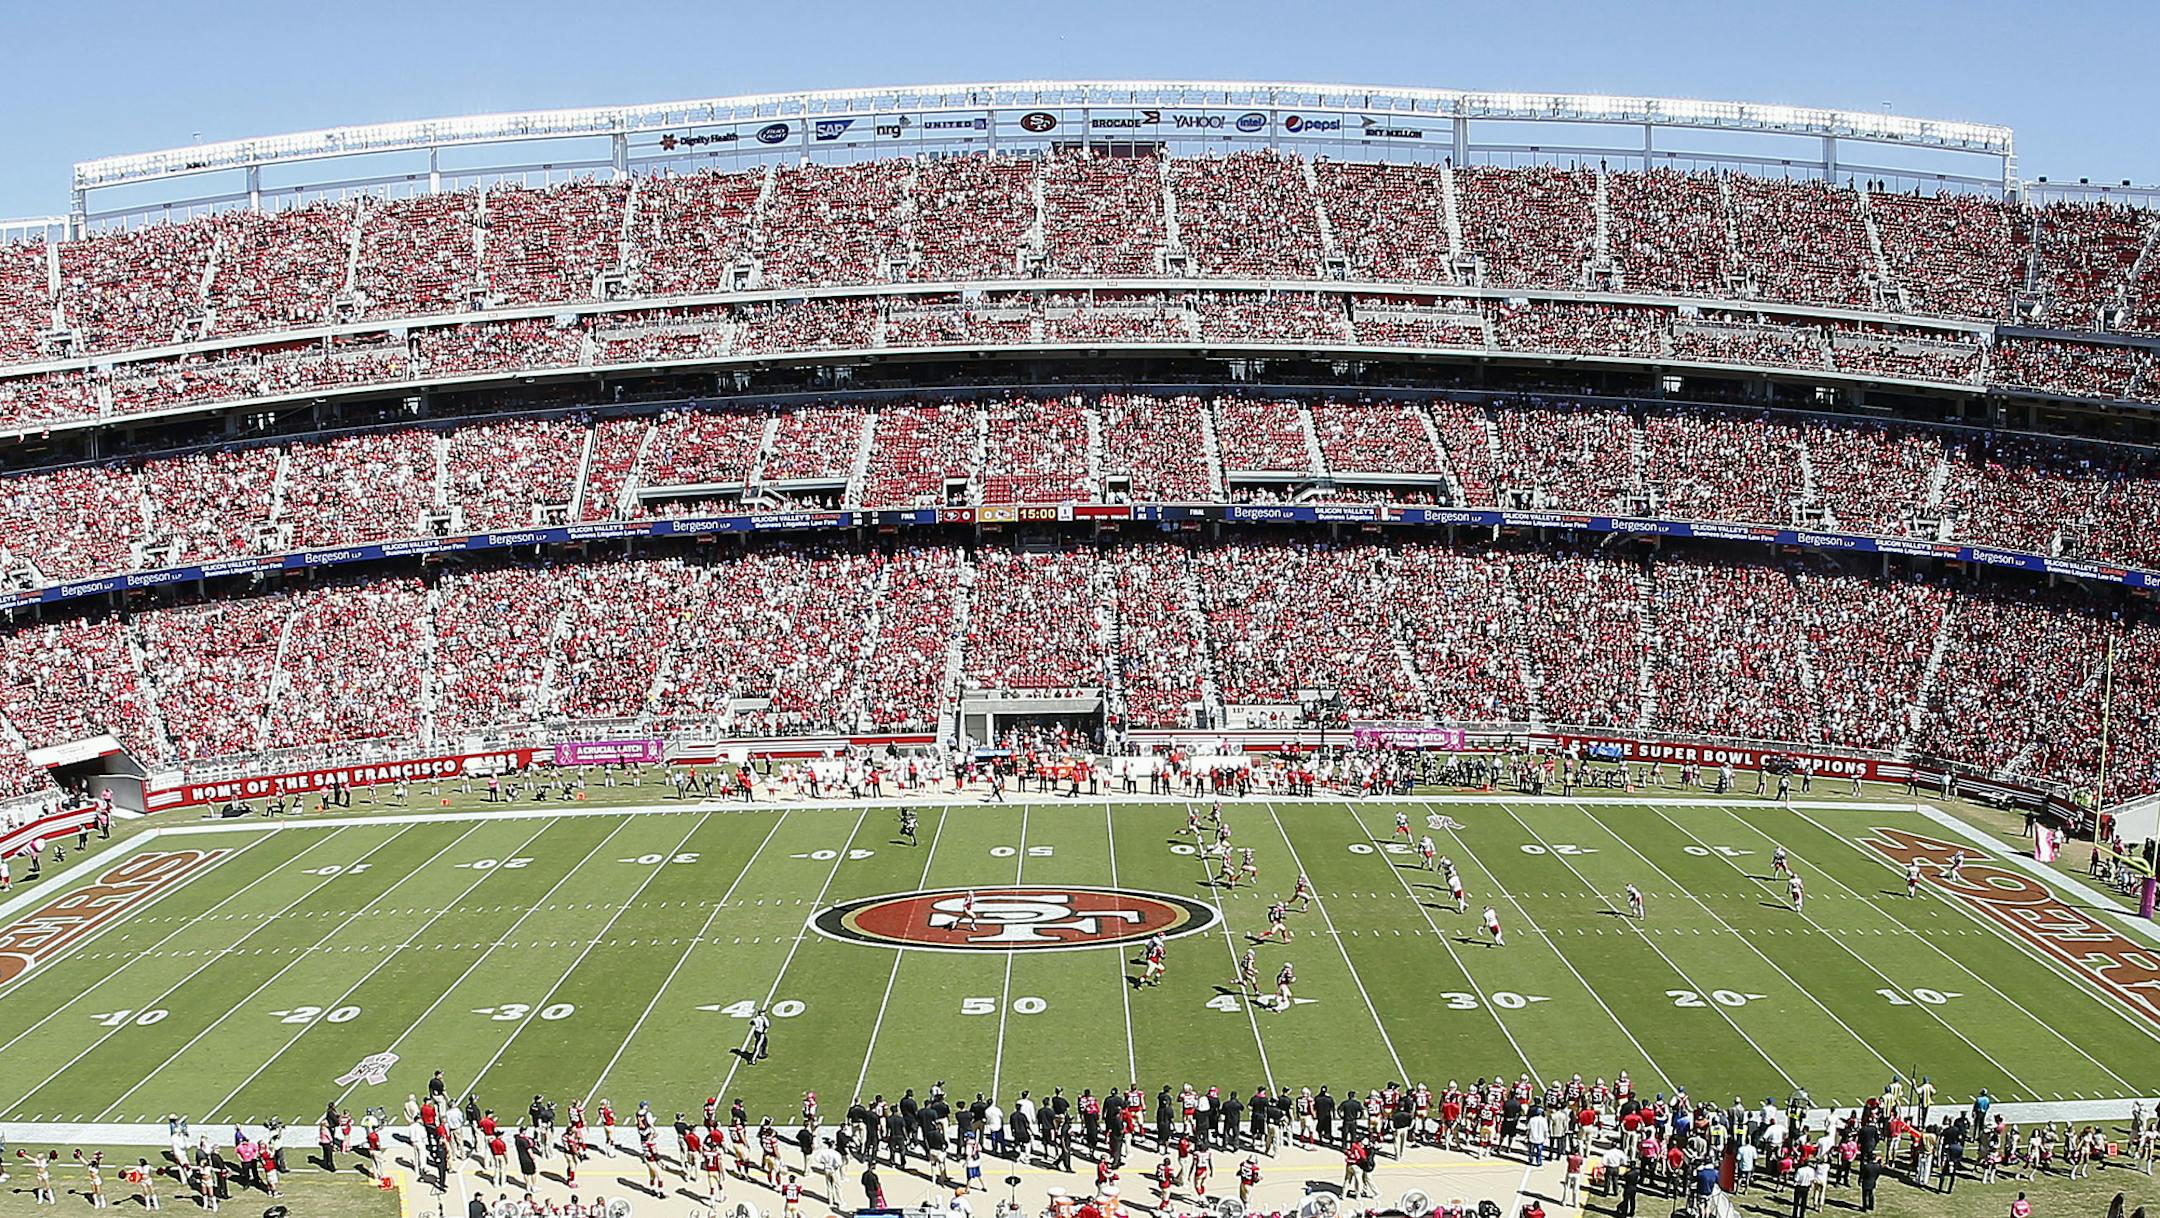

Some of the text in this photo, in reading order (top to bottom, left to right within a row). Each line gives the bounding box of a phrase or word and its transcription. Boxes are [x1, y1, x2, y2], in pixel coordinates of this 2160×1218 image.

[1092, 119, 1141, 128] BROCADE
[1173, 115, 1226, 128] YAHOO!
[1240, 116, 1261, 127] intel
[1304, 119, 1341, 133] pepsi
[816, 124, 844, 137] SAP
[876, 125, 901, 138] nrg
[680, 133, 738, 149] Dignity Health
[751, 515, 779, 523] SILICON
[779, 514, 811, 522] VALLEY'S
[1020, 509, 1056, 519] 15:00
[1234, 507, 1282, 520] Bergeson
[1424, 510, 1470, 523] Bergeson
[1502, 512, 1530, 520] SILICON
[1530, 513, 1561, 521] VALLEY'S
[567, 526, 594, 534] SILICON
[594, 524, 624, 532] VALLEY'S
[672, 521, 719, 534] Bergeson
[1611, 518, 1657, 532] Bergeson
[1690, 523, 1717, 531] SILICON
[1718, 525, 1749, 534] VALLEY'S
[382, 543, 409, 551] SILICON
[410, 539, 439, 549] VALLEY'S
[489, 532, 535, 545] Bergeson
[1798, 532, 1843, 546] Bergeson
[1875, 539, 1902, 547] SILICON
[1903, 541, 1932, 550] VALLEY'S
[305, 551, 350, 565] Bergeson
[1972, 549, 2014, 564] Bergeson
[201, 563, 230, 573] SILICON
[231, 559, 257, 568] VALLEY'S
[2044, 558, 2069, 568] SILICON
[2070, 562, 2098, 572] VALLEY'S
[127, 571, 182, 587] Bergeson LLP
[61, 582, 103, 597] Bergeson
[583, 746, 617, 755] CRUCIAL
[618, 744, 643, 753] CATCH
[1639, 745, 1698, 761] SUPER
[1703, 750, 1754, 766] BOWL
[1760, 754, 1867, 776] CMPIONS
[192, 783, 242, 801] HOME
[247, 779, 269, 794] OF
[275, 775, 309, 791] THE
[314, 771, 349, 786] SAN
[354, 760, 456, 783] FRANCISCO
